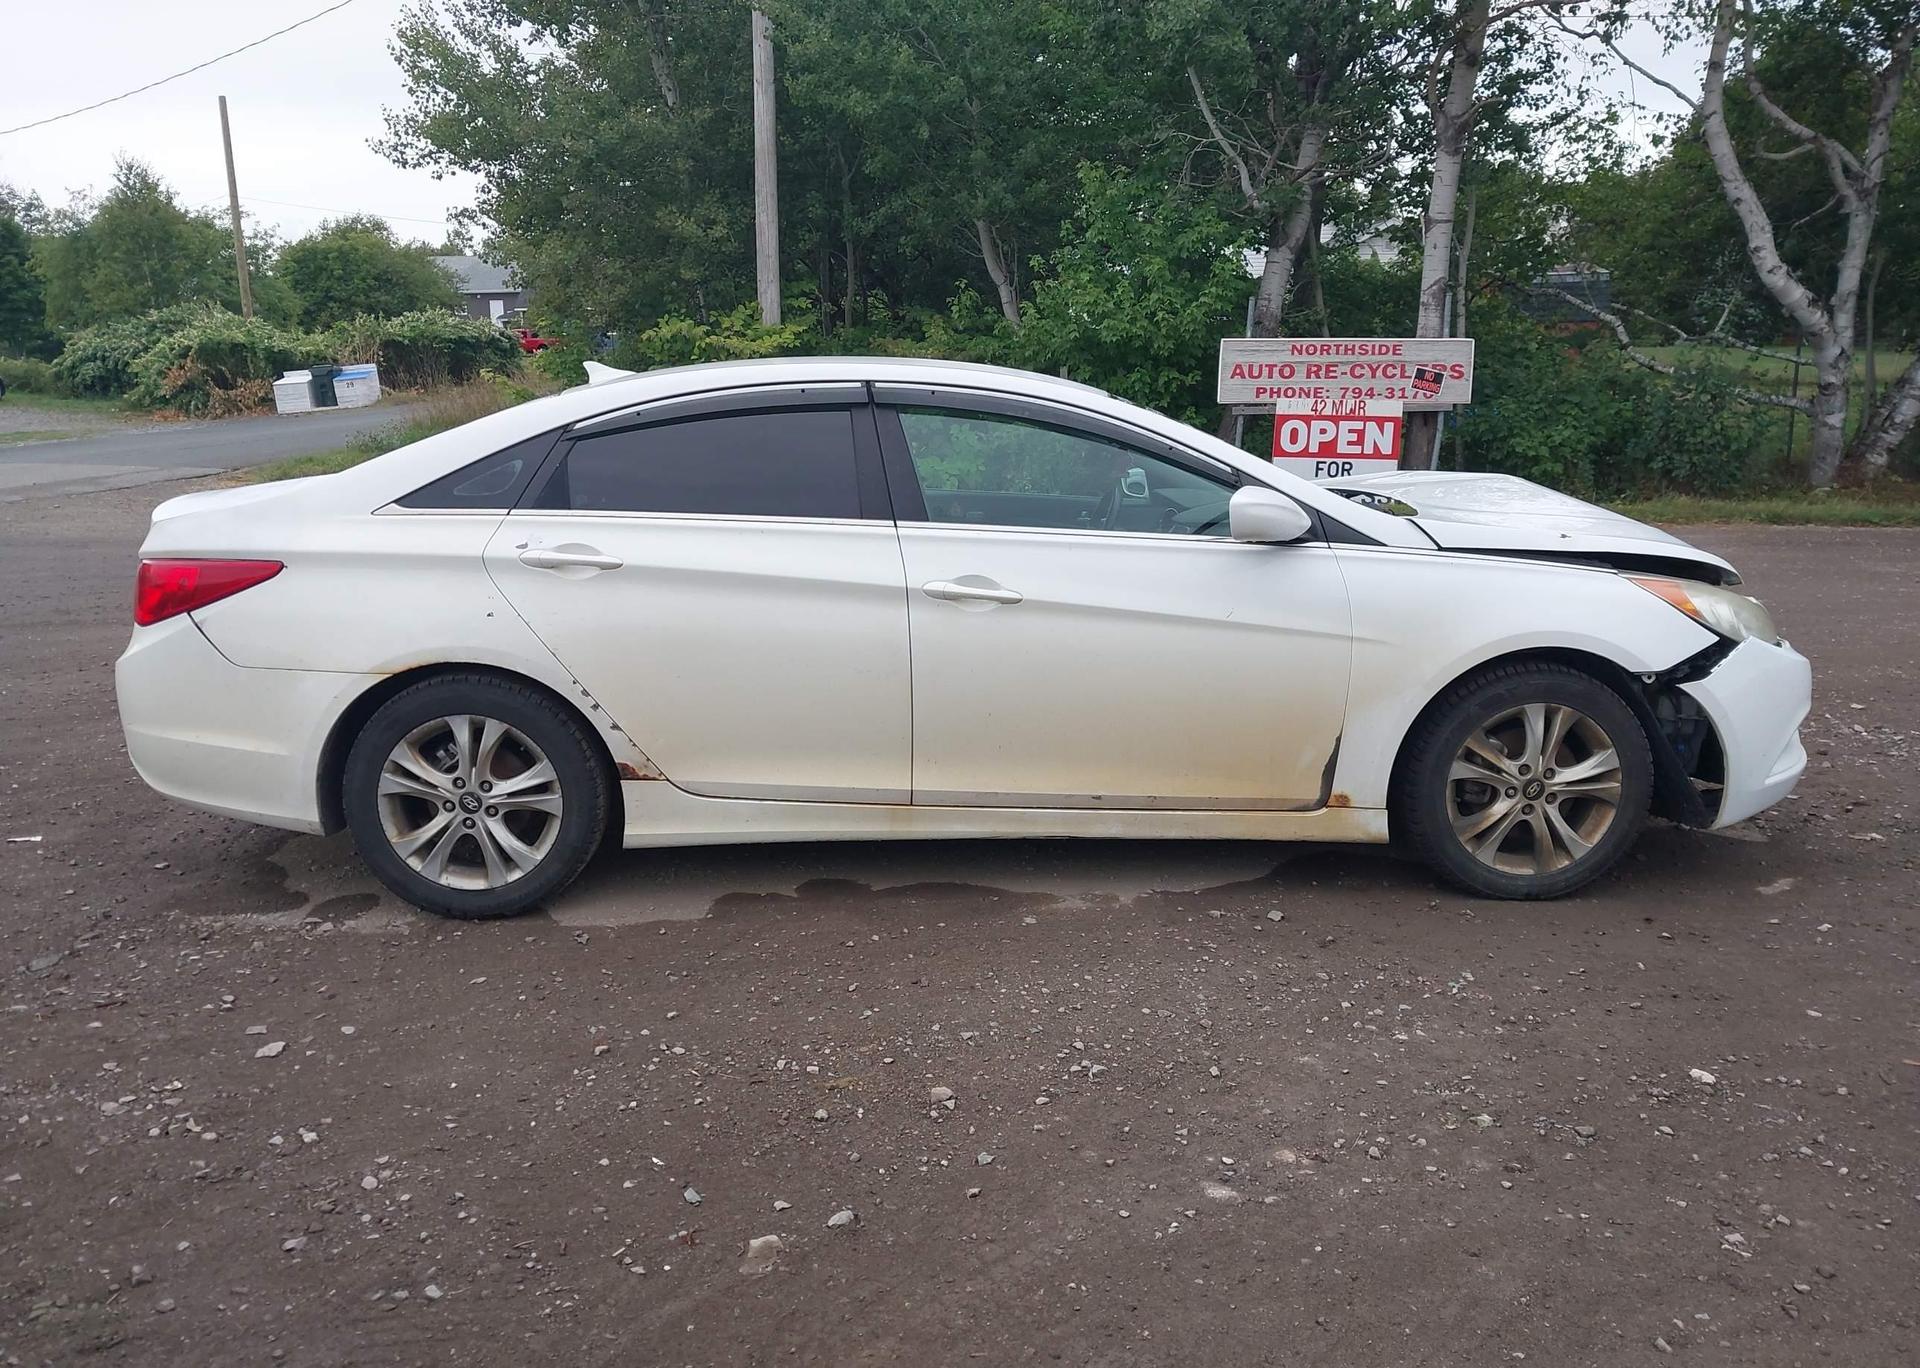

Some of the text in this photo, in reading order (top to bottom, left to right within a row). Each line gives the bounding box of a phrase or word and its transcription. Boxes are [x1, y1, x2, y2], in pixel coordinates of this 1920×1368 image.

[1290, 343, 1403, 356] NORTHSIDE
[1230, 363, 1296, 380] AUTO
[1424, 371, 1435, 381] NO
[1255, 386, 1331, 399] PHONE:
[1413, 379, 1441, 393] PARKING
[1280, 419, 1394, 455] OPEN
[1315, 461, 1353, 478] FOR
